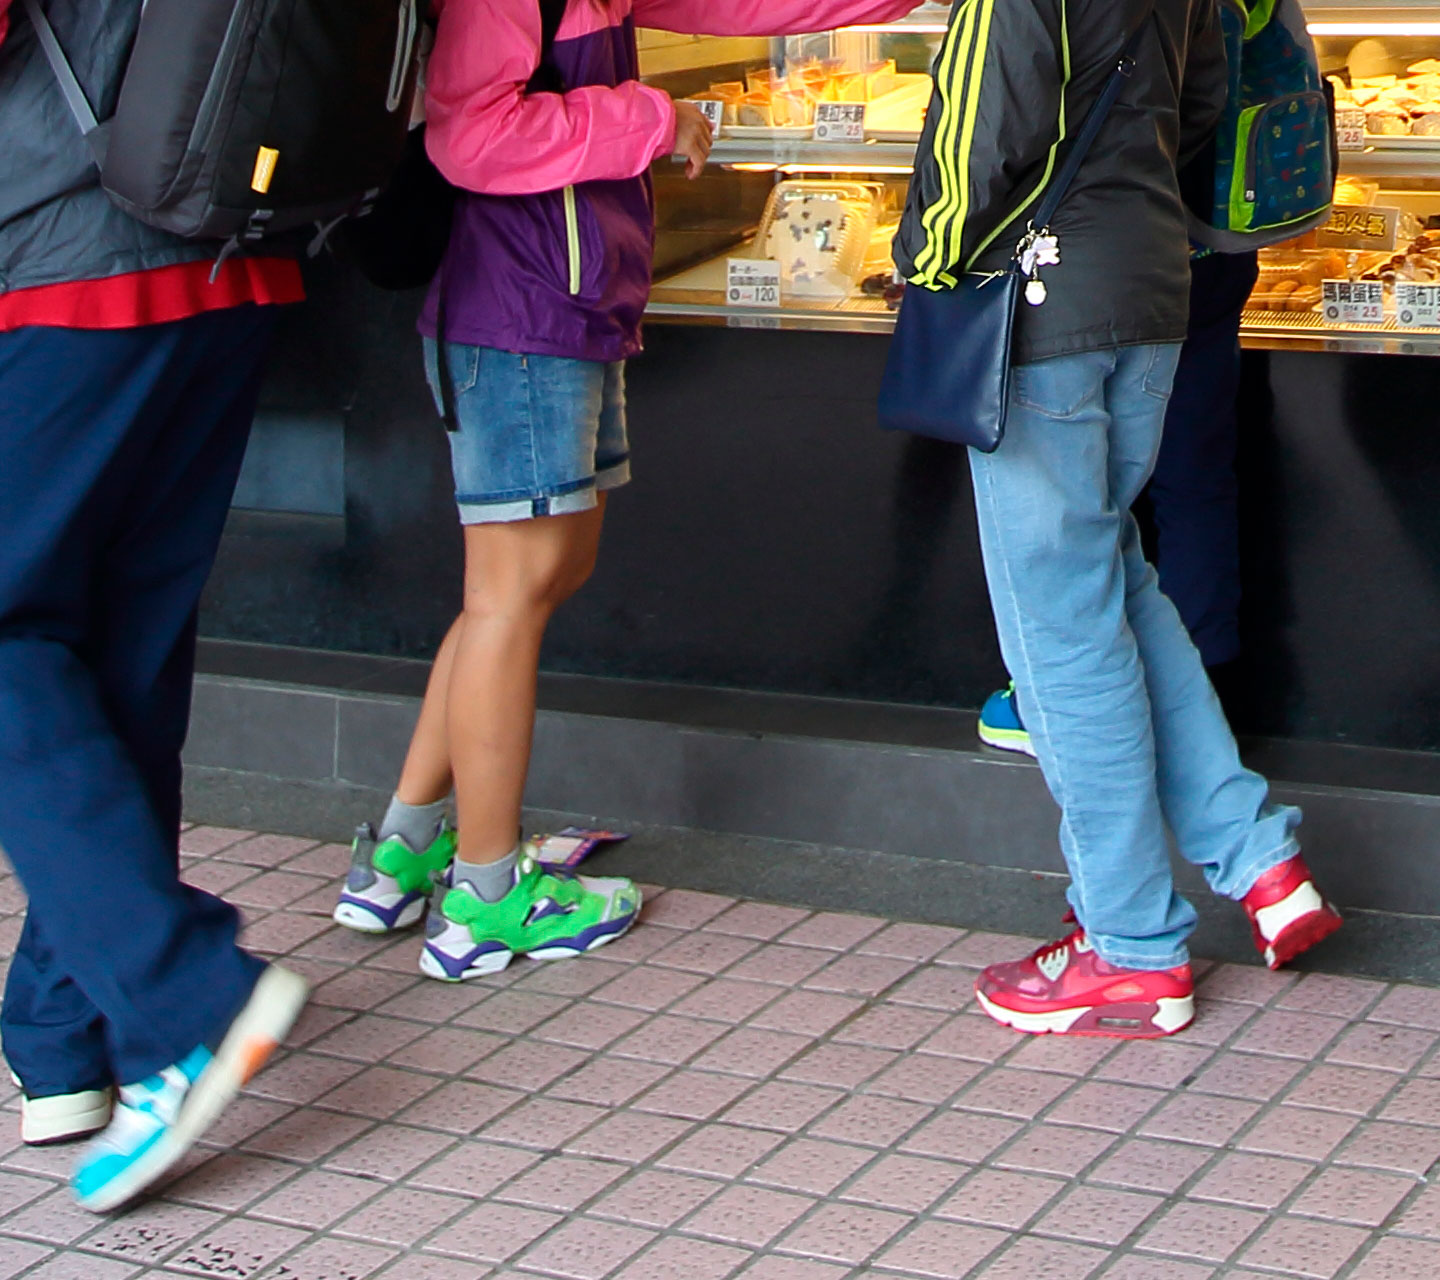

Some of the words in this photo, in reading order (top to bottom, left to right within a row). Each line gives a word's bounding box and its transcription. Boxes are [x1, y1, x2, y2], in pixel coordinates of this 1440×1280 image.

[846, 124, 860, 136] 25
[1344, 131, 1359, 143] 25
[755, 287, 776, 302] 120
[1363, 306, 1378, 318] 25
